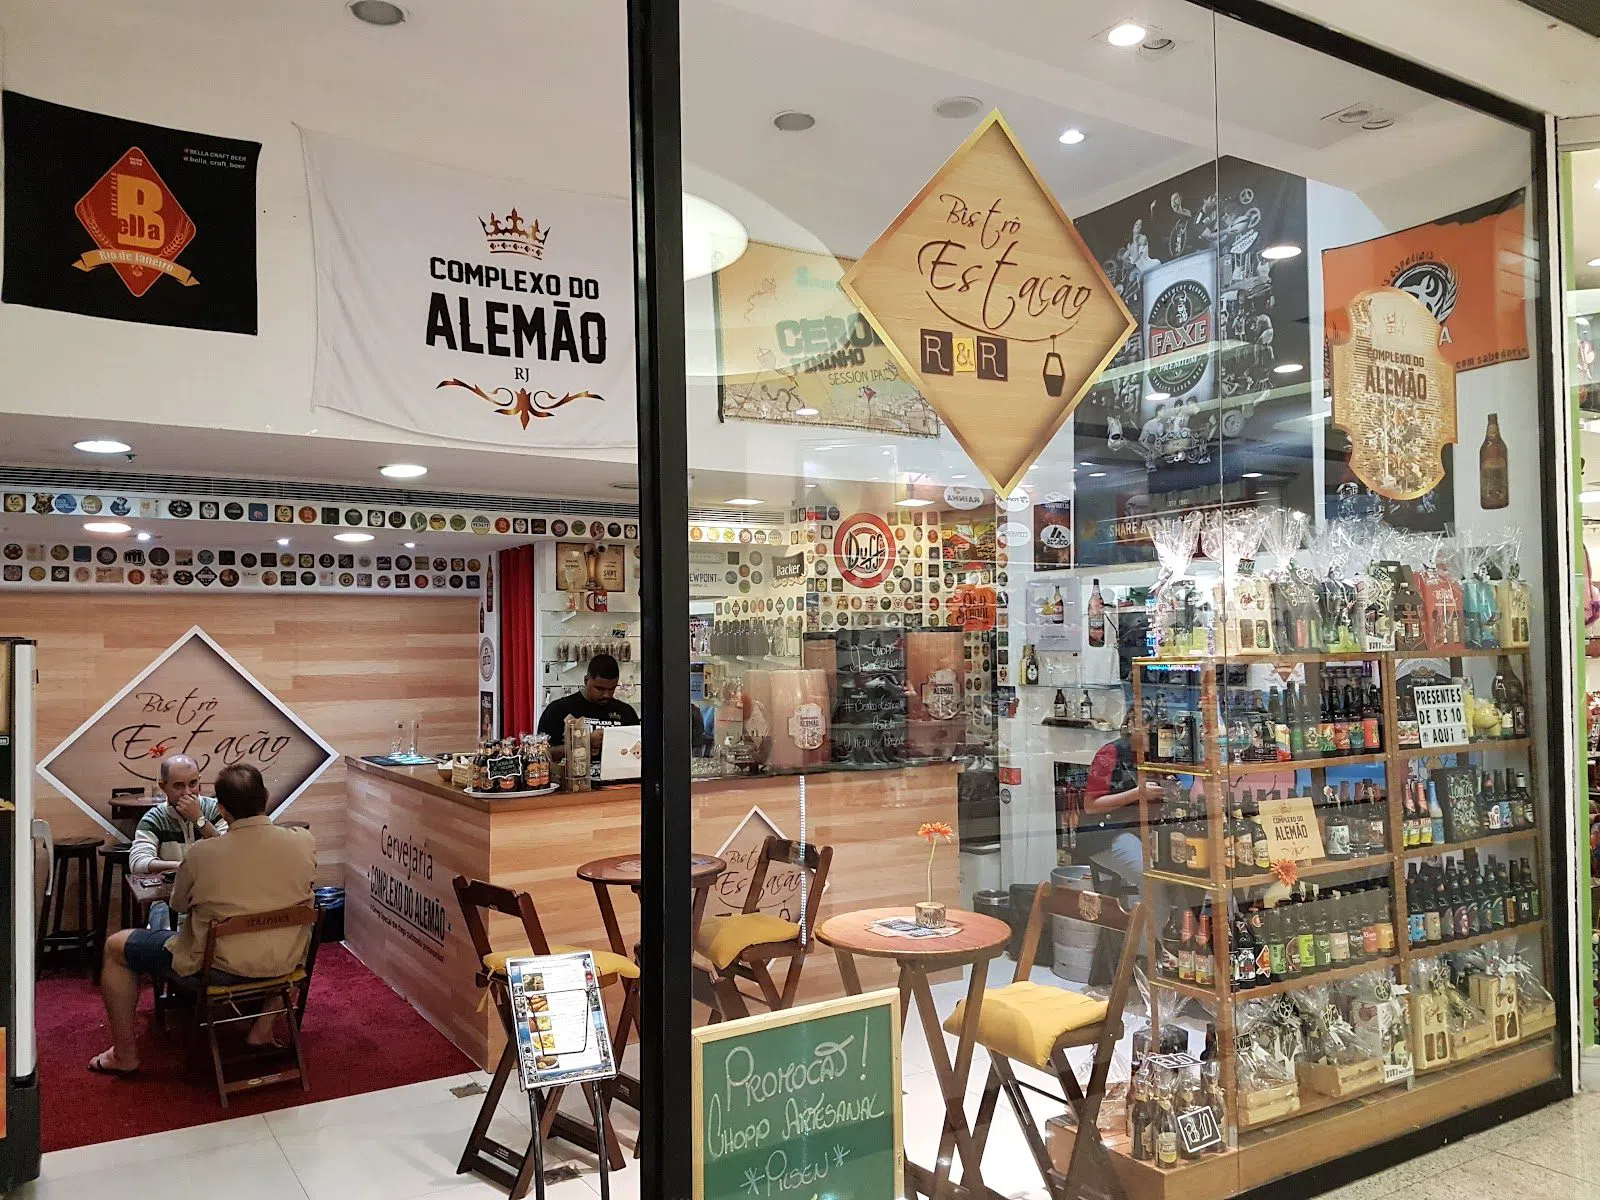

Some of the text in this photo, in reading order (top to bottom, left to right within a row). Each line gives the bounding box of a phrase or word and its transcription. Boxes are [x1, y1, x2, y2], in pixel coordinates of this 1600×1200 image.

[189, 149, 247, 162] BELLA CRAFT BEER
[940, 193, 1021, 249] Bistrô
[430, 256, 599, 300] COMPLEXO DO
[917, 239, 1092, 330] Estação
[426, 291, 607, 365] ALEMÃO
[776, 312, 884, 355] CERO
[1151, 320, 1207, 357] FAXE
[1159, 356, 1197, 373] PREMIUM
[1366, 347, 1425, 368] COMPLEXO DO
[514, 367, 529, 383] RJ
[828, 370, 869, 386] SESSION
[1366, 366, 1427, 401] ALEMÃO
[1108, 521, 1138, 537] SHARE
[845, 531, 886, 573] Duff
[777, 563, 801, 577] Backer
[136, 687, 218, 725] Bistrô
[1415, 688, 1462, 706] PRESENTES
[1419, 709, 1432, 725] DE
[1452, 707, 1462, 722] 10
[1272, 816, 1296, 824] COMPLEXO
[1274, 822, 1309, 842] ALEMÃO
[381, 824, 433, 882] Cervejaria
[370, 864, 403, 912] COMPLEXO
[403, 884, 414, 920] DO
[414, 891, 446, 941] ALEMÃO
